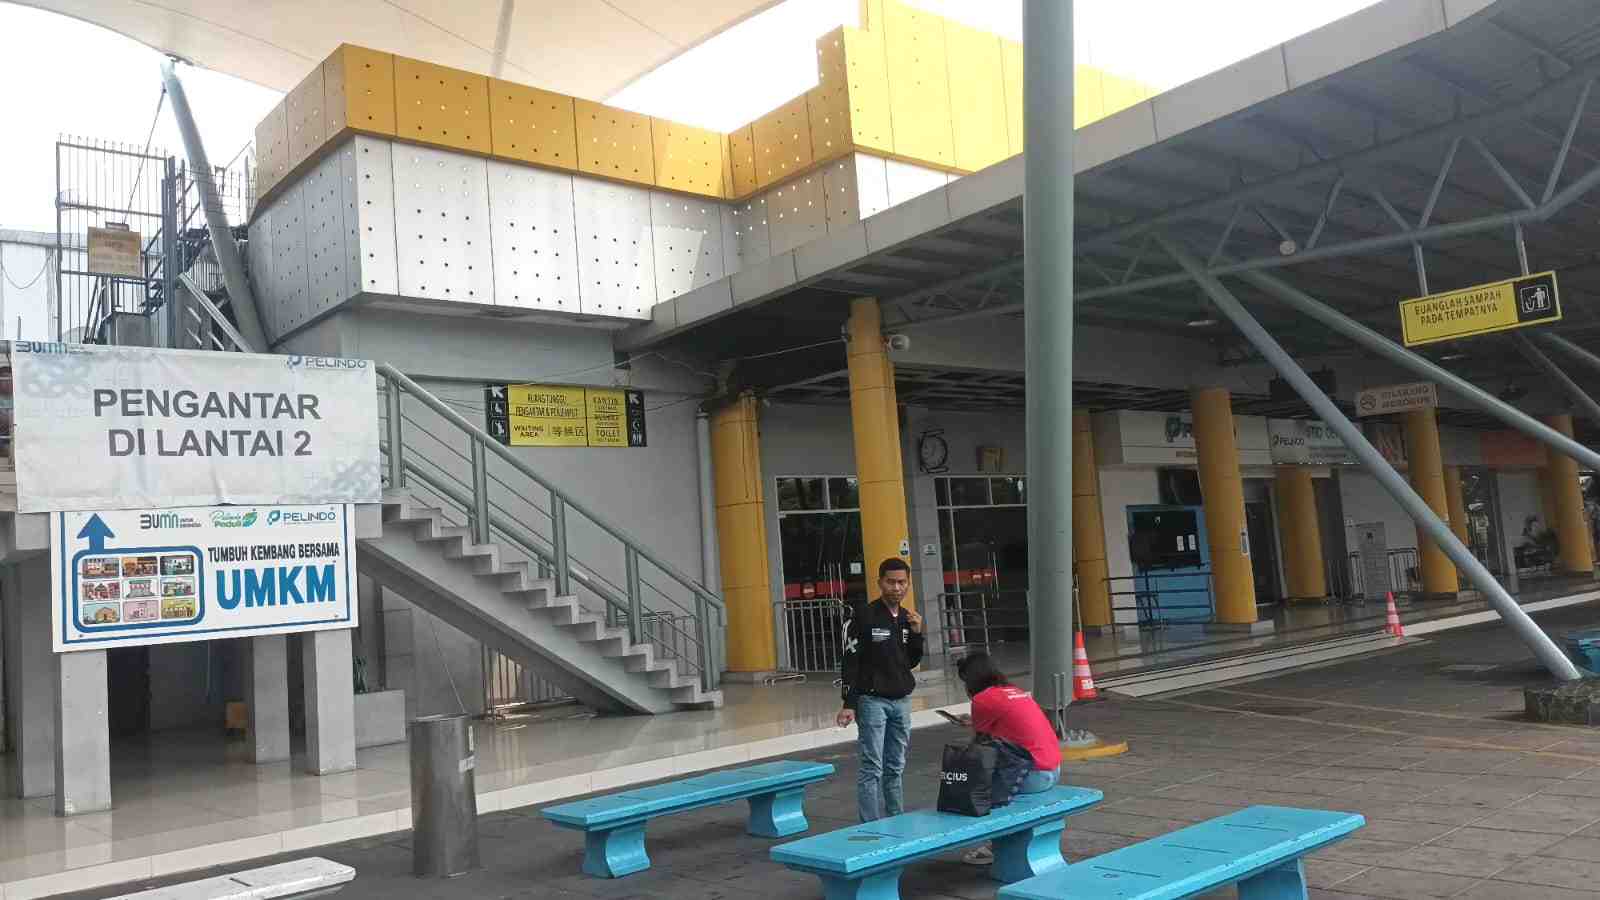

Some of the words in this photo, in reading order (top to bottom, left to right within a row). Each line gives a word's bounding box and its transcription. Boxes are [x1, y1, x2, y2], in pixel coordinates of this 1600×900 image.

[1464, 290, 1501, 306] SAMPAH
[1420, 313, 1443, 325] PADA
[1446, 303, 1498, 320] TEMPATNYA
[305, 357, 368, 369] PELINDO
[94, 389, 321, 420] PENGANTAR
[109, 428, 145, 457] DI
[158, 430, 284, 457] LANTAI
[294, 431, 312, 456] 2
[282, 511, 337, 522] PELINDO
[208, 546, 248, 563] TUMBUH
[251, 544, 296, 561] KEMBANG
[299, 542, 340, 559] BERSAMA
[215, 564, 336, 610] UMKM
